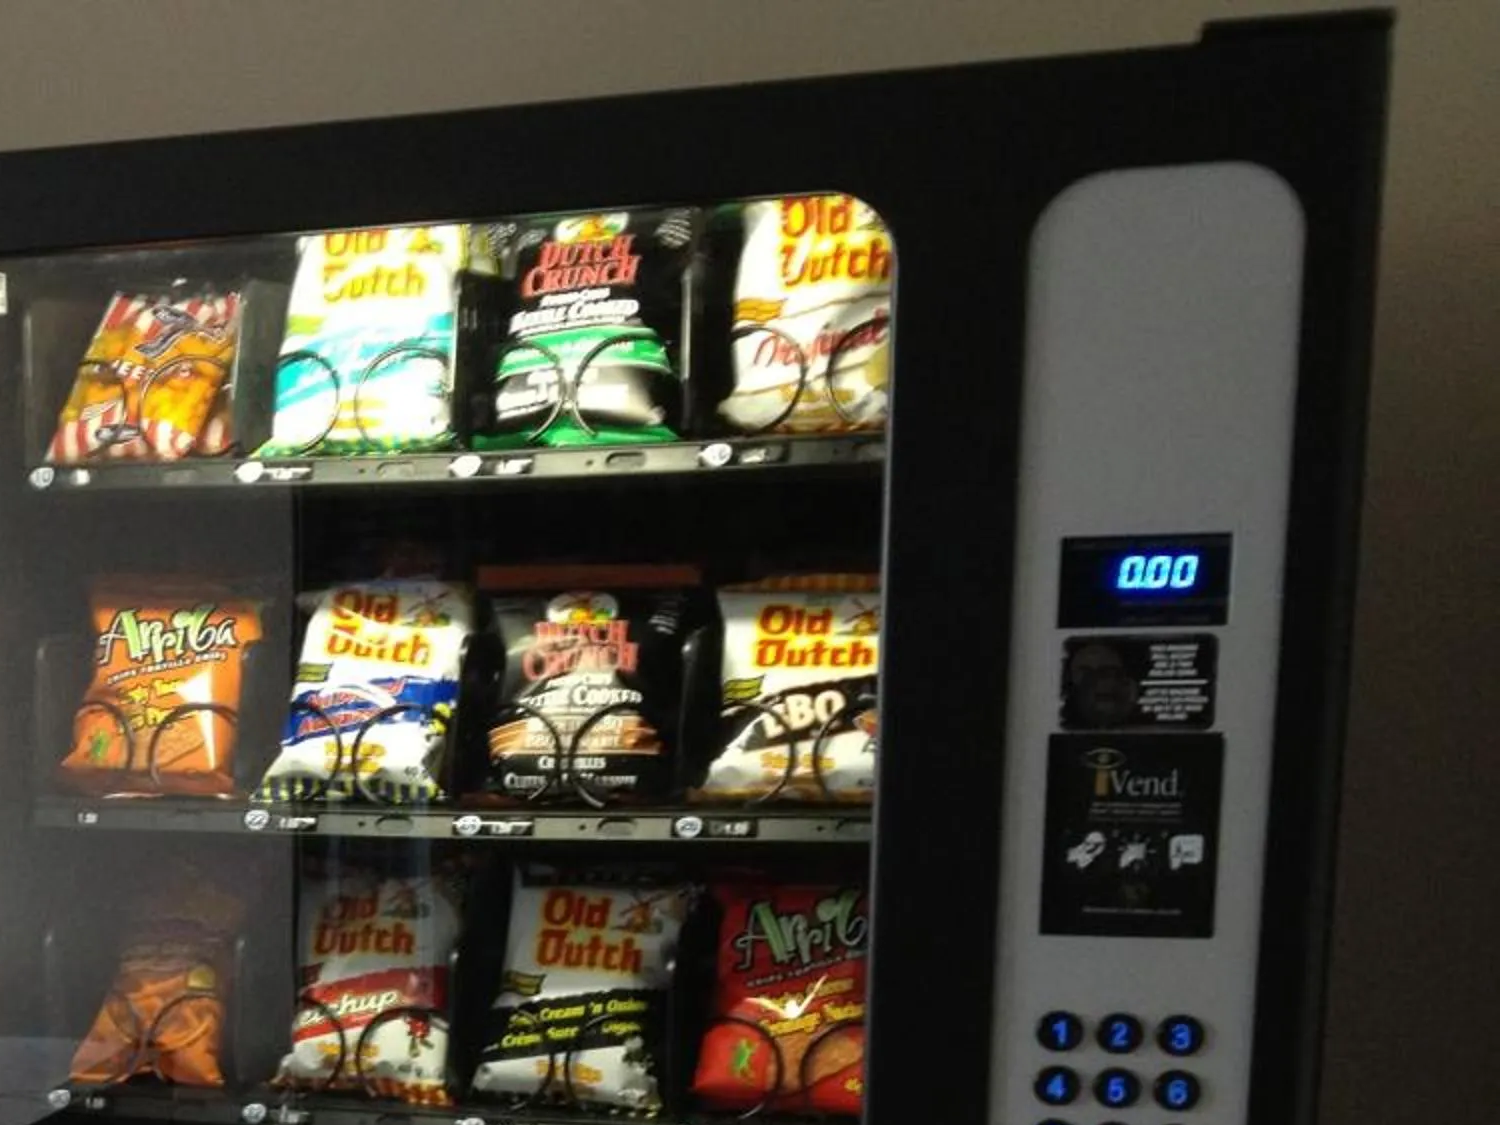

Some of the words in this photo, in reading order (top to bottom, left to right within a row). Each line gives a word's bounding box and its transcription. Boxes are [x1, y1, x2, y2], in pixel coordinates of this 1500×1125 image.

[521, 255, 642, 299] CRUNCH
[1116, 555, 1198, 590] 0.00
[333, 588, 399, 622] Old
[759, 604, 834, 635] Old
[98, 603, 237, 664] Arriba
[327, 623, 429, 665] Dutch
[755, 639, 873, 667] Dutch
[544, 888, 612, 928] Old
[314, 922, 414, 956] Dutch
[734, 891, 868, 970] Arrib
[537, 929, 643, 973] Dutch
[1053, 1019, 1067, 1045] 1
[1111, 1021, 1128, 1047] 2
[1170, 1023, 1191, 1049] 3
[1046, 1074, 1064, 1099] 4
[1108, 1077, 1125, 1103] 5
[1168, 1079, 1188, 1105] 6
